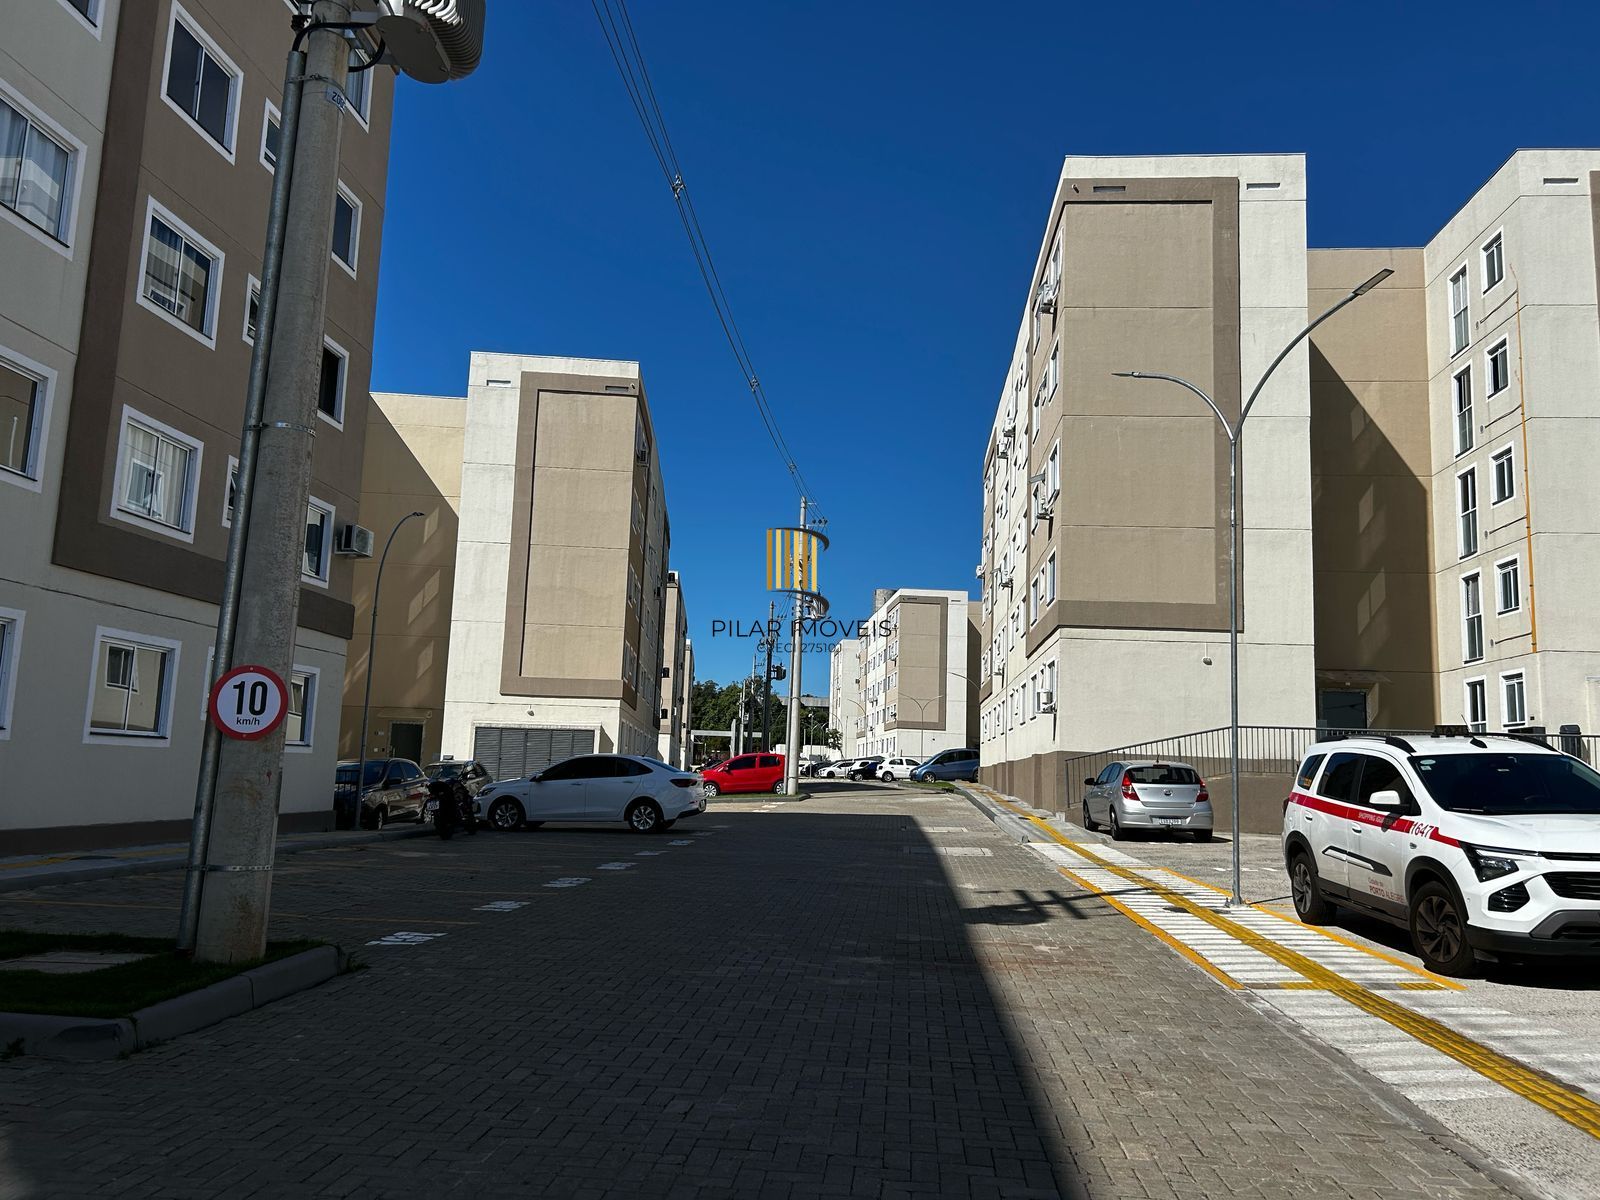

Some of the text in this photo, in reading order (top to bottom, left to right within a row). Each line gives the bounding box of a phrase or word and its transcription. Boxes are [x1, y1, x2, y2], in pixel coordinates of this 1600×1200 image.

[233, 680, 268, 716] 10
[236, 717, 260, 726] km/h
[1410, 822, 1435, 838] 1647
